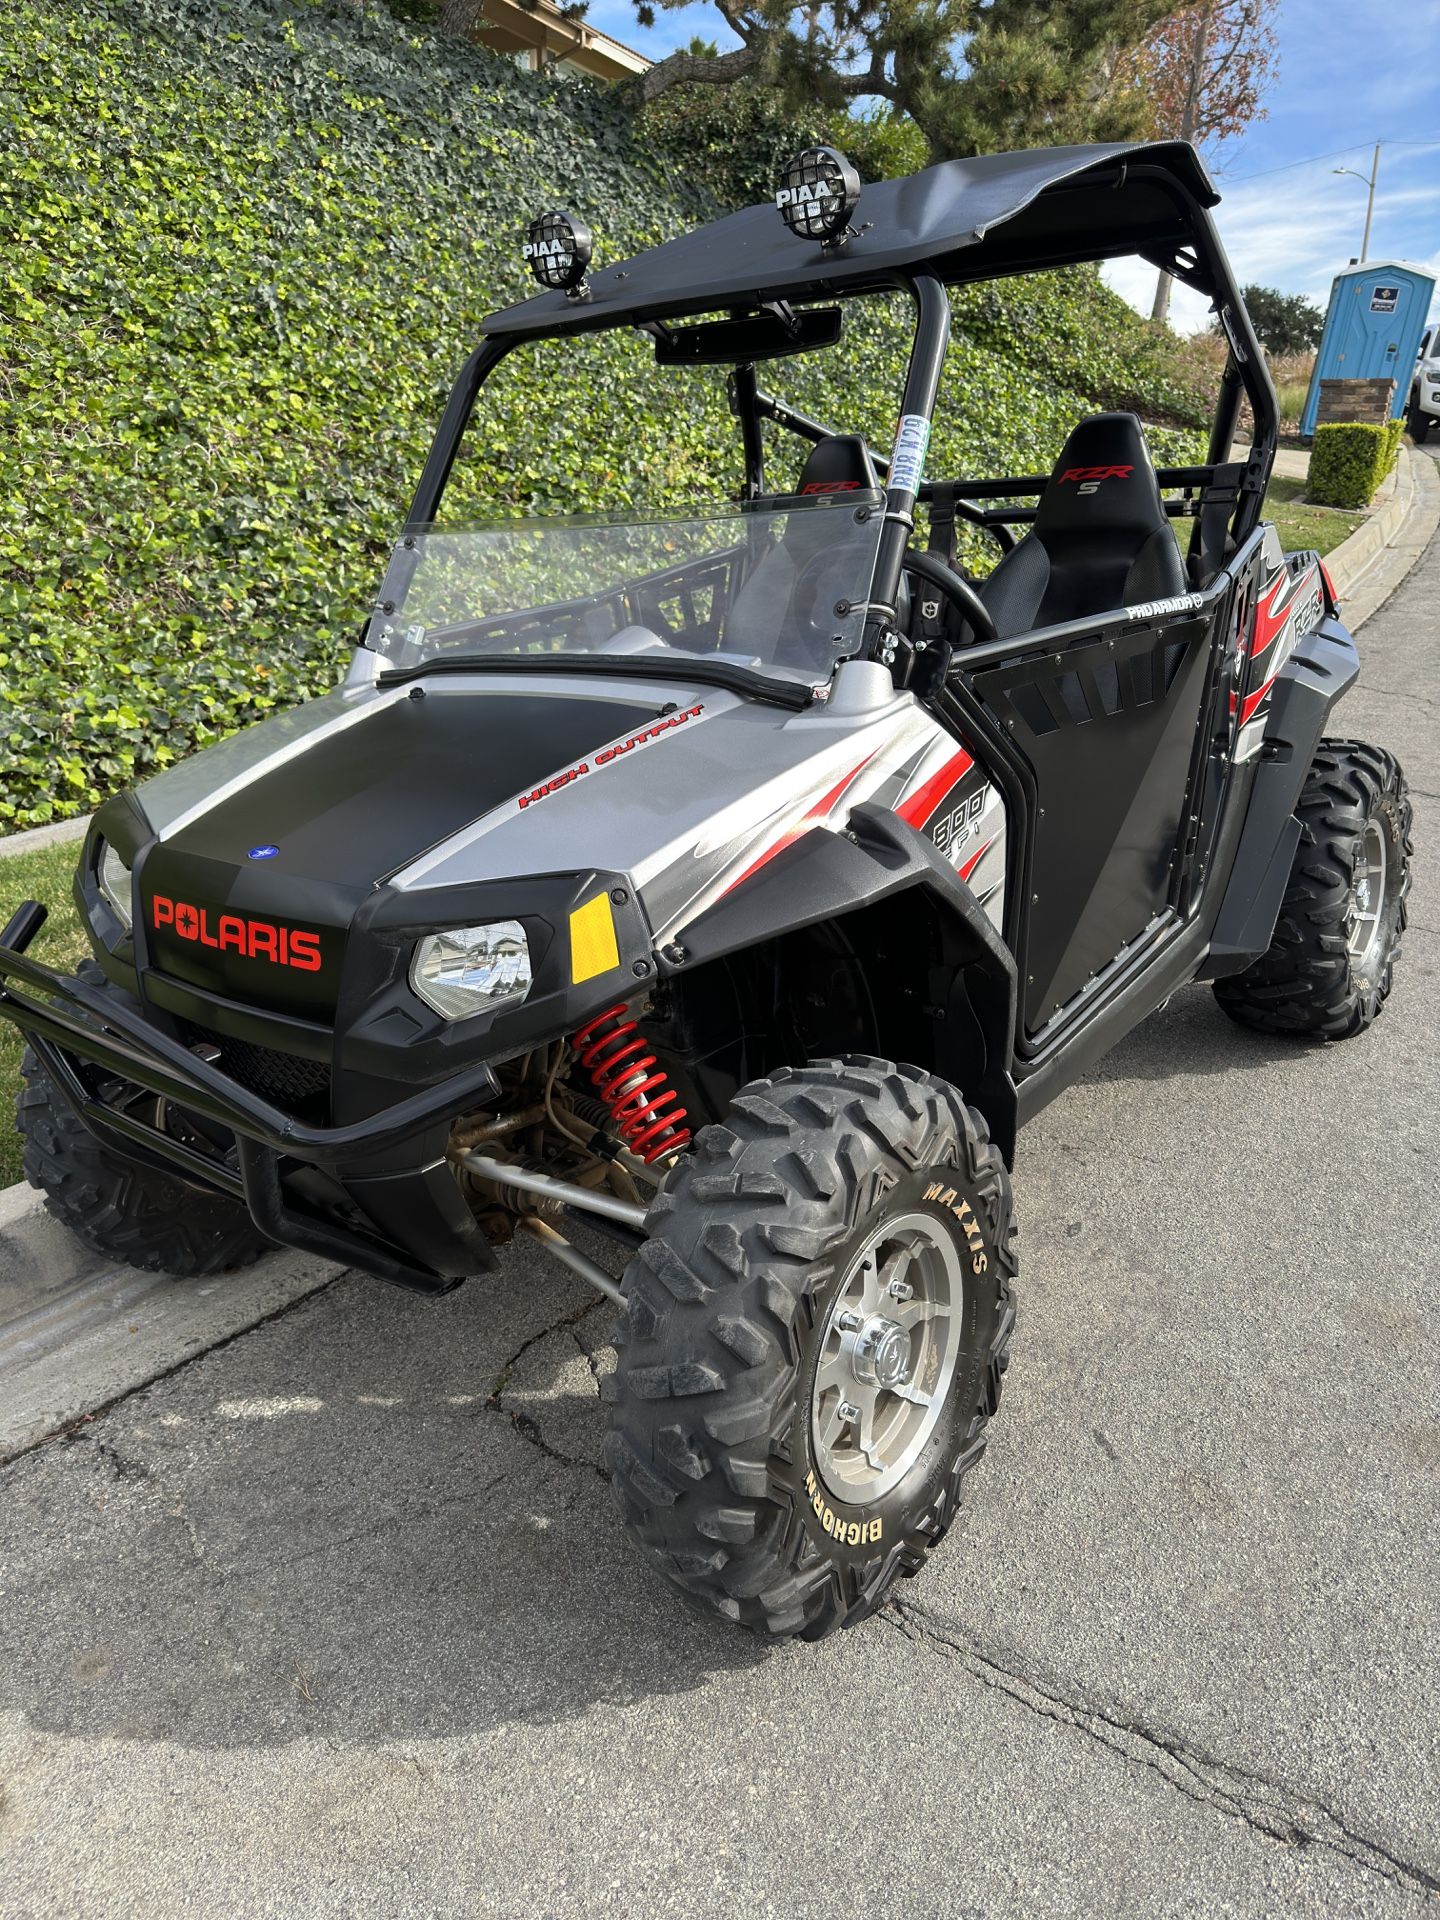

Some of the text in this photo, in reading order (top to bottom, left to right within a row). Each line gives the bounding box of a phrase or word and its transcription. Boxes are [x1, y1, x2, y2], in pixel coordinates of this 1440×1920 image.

[775, 180, 832, 209] PIAA
[522, 239, 565, 260] PIAA
[801, 481, 861, 496] RZR
[1057, 465, 1135, 485] RZR
[1077, 481, 1101, 495] S
[816, 496, 834, 507] S
[518, 703, 705, 810] HIGH OUTPUT
[932, 785, 986, 850] 800
[152, 894, 322, 972] POLARIS
[922, 1181, 989, 1276] MAXXIS
[803, 1469, 883, 1547] BIGHORN
